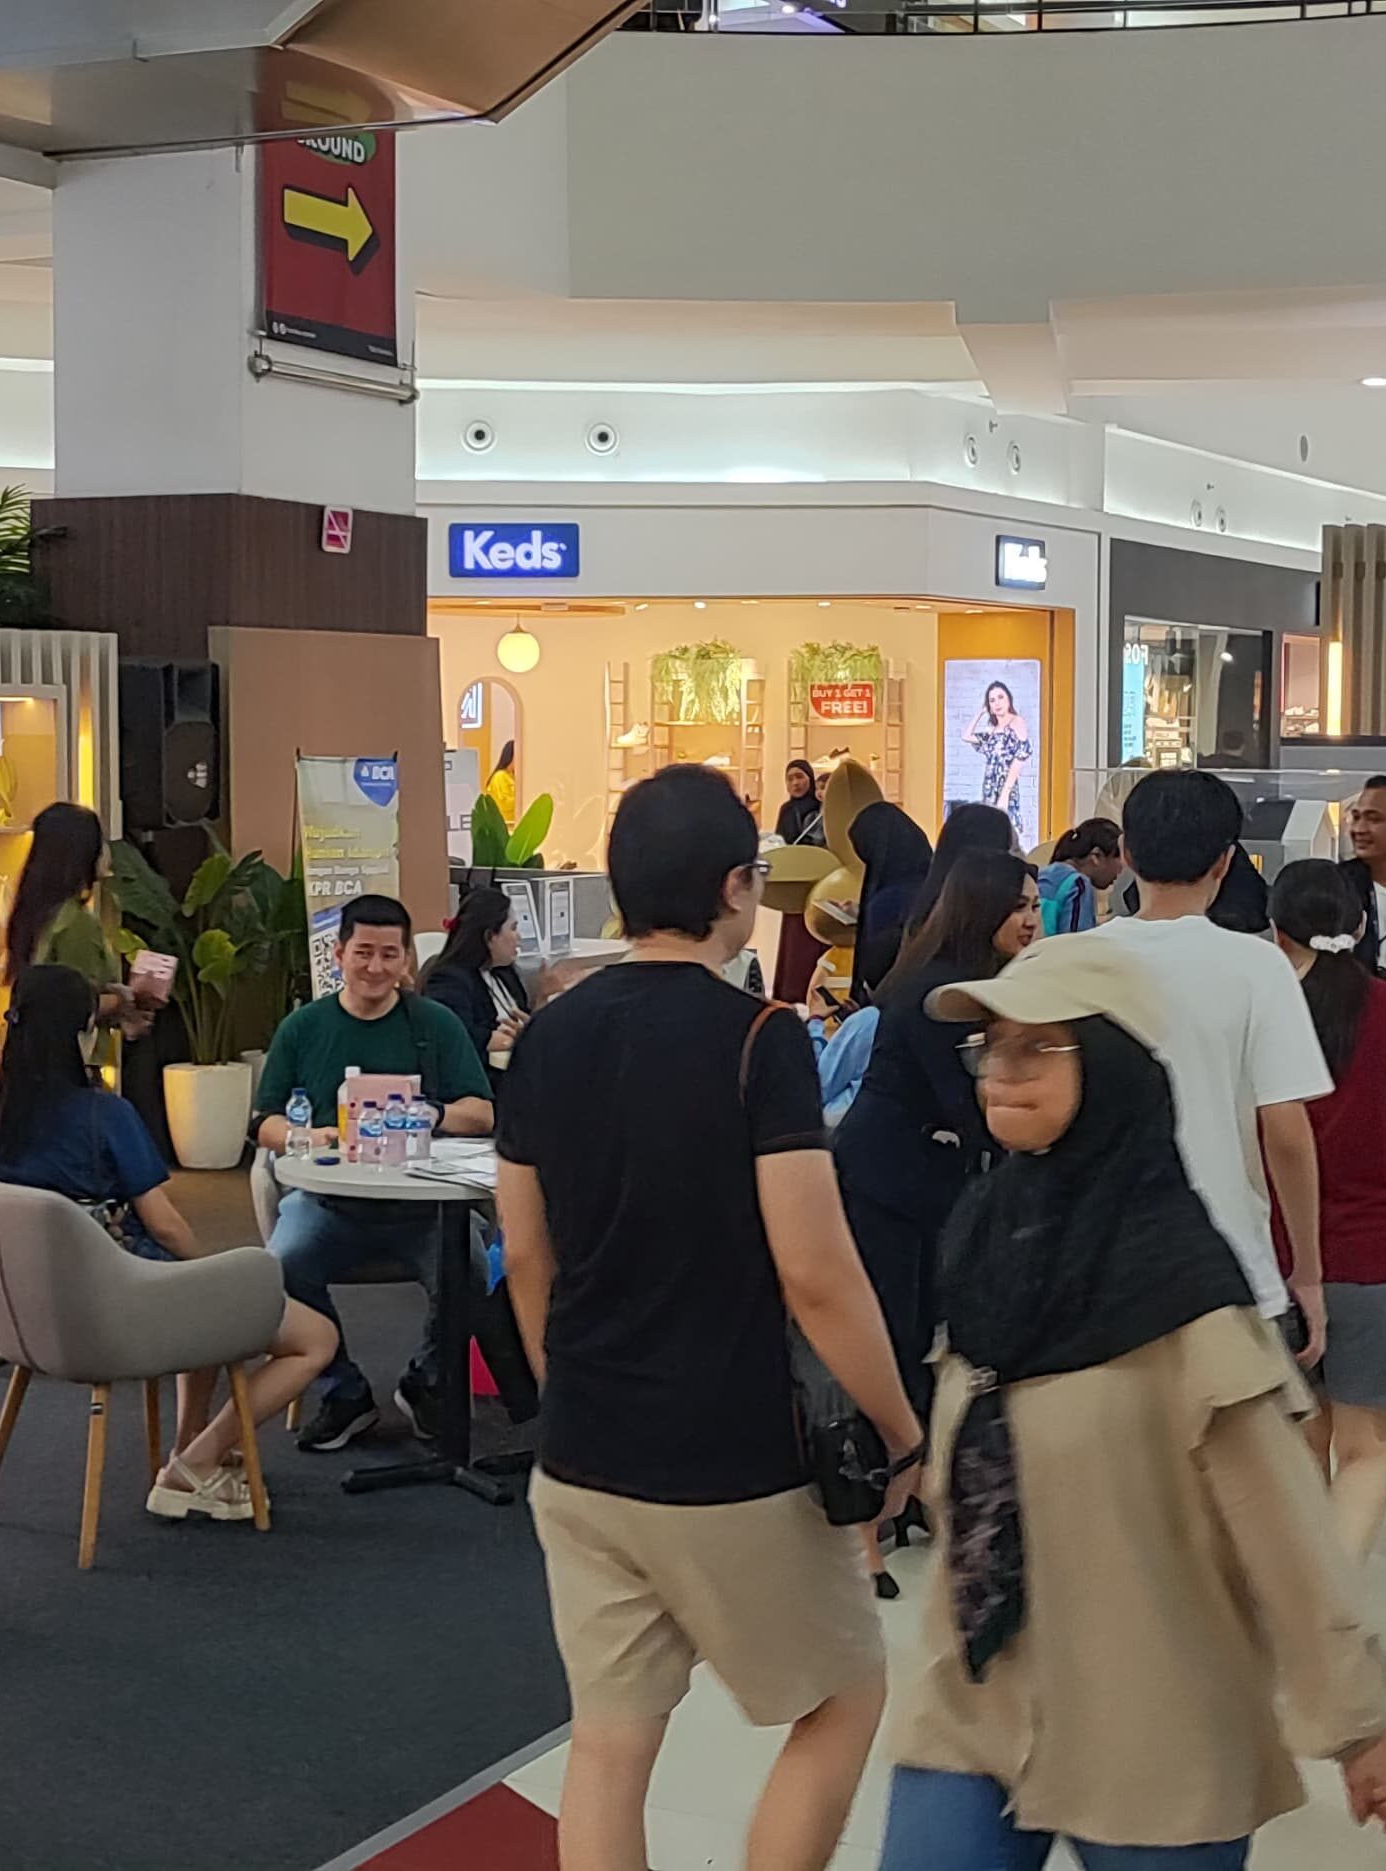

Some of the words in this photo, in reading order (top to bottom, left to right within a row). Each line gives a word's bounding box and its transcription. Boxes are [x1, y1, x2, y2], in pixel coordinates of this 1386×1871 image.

[298, 136, 365, 163] OUND
[464, 530, 564, 570] Keds
[813, 690, 832, 698] BUY
[835, 689, 842, 698] 1
[843, 689, 863, 698] GET
[865, 689, 871, 698] 1
[821, 701, 868, 714] FREE!
